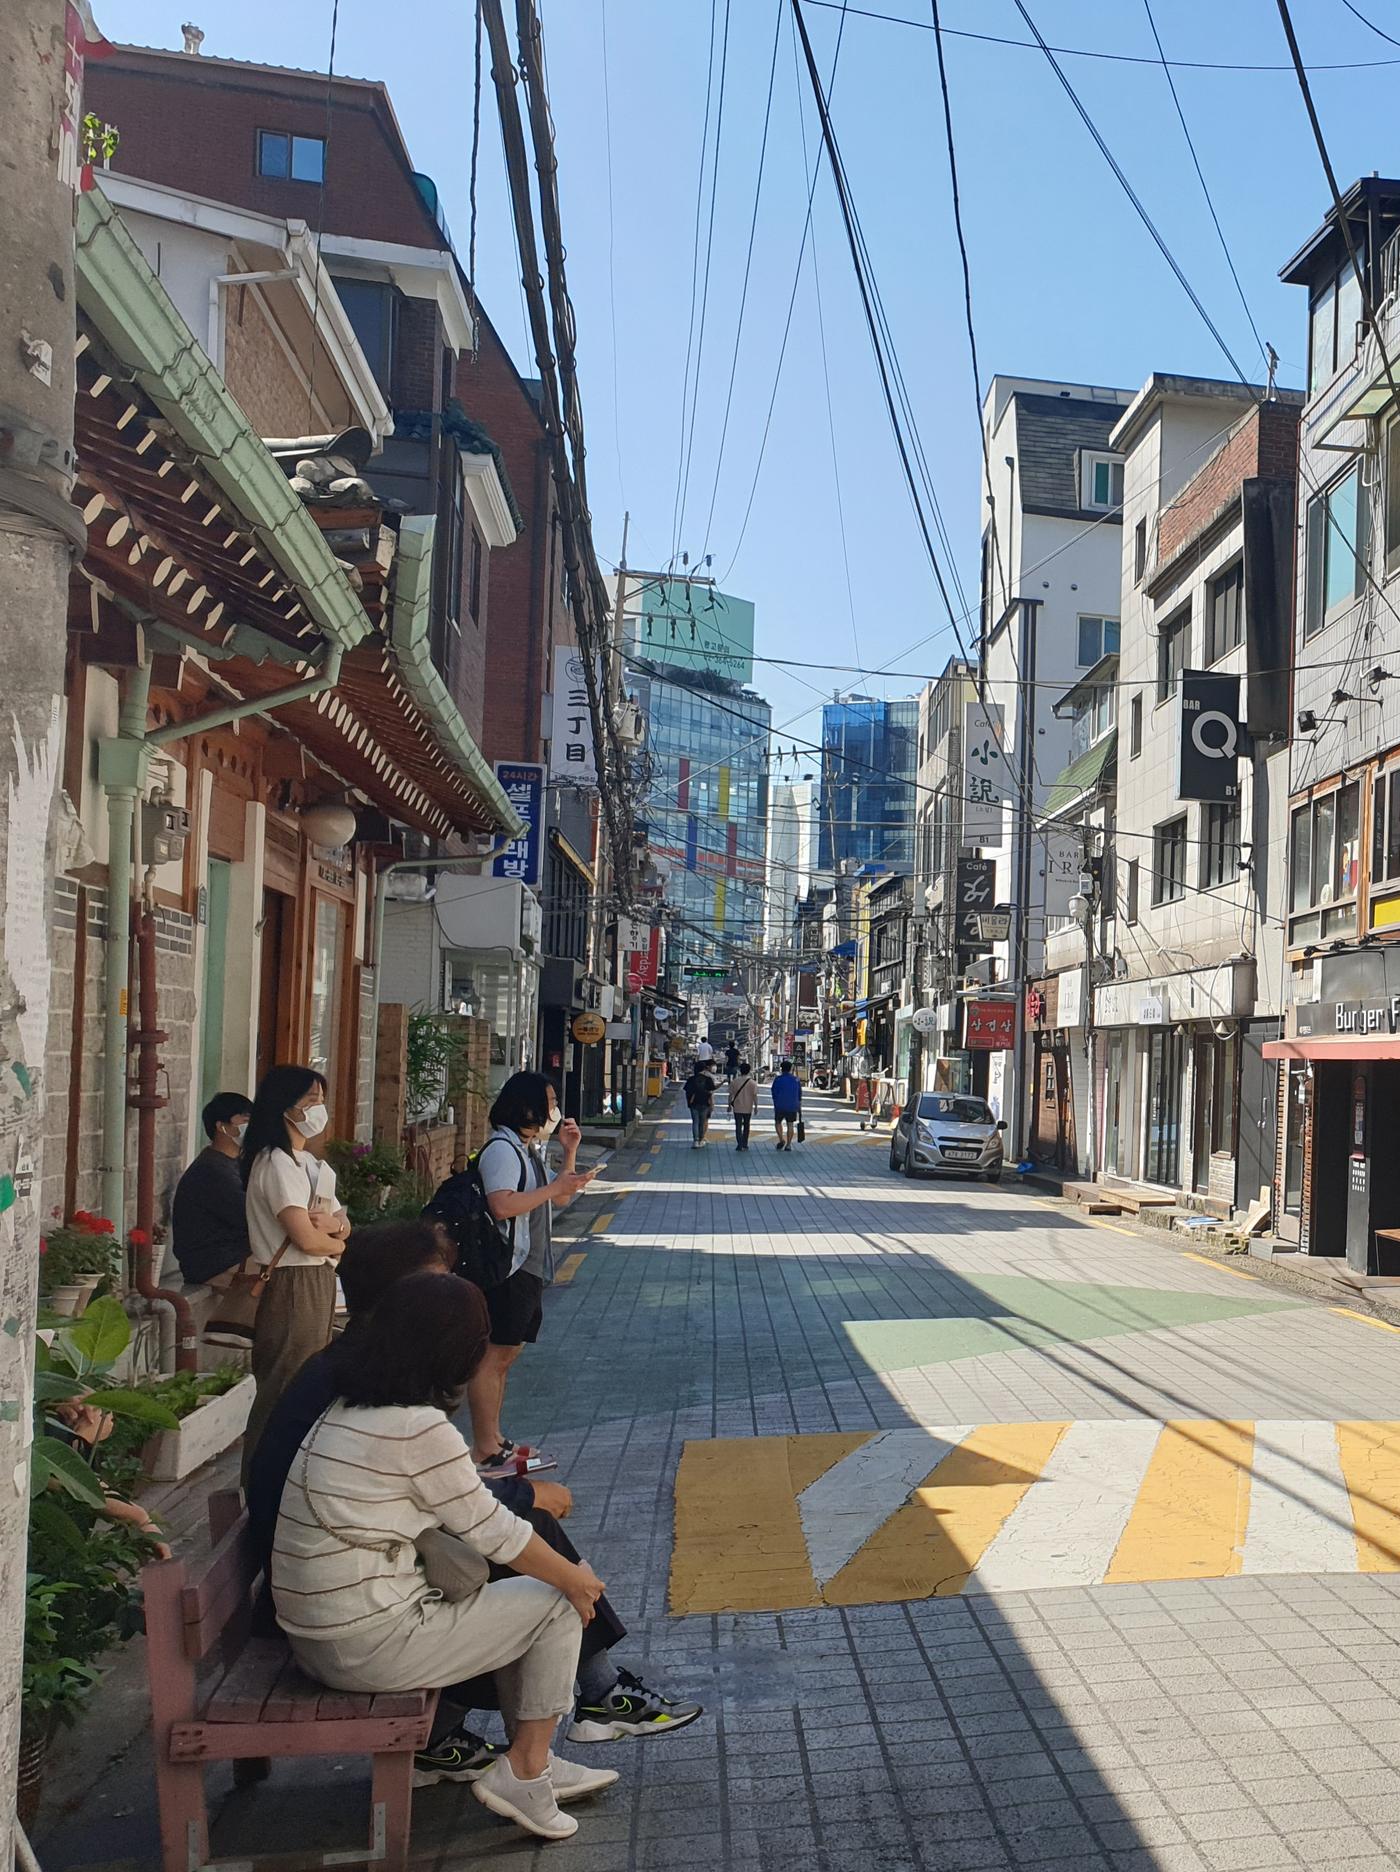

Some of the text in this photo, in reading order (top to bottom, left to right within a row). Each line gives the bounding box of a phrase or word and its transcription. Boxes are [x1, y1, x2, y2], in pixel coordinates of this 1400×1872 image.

[1183, 699, 1201, 711] BAR
[567, 689, 588, 762] 三丁目
[1191, 710, 1237, 759] Q
[503, 770, 540, 781] 24시간
[1225, 785, 1237, 796] B1
[502, 783, 532, 878] 셀프래방
[1059, 850, 1079, 859] BAR
[1335, 1002, 1385, 1033] Burger
